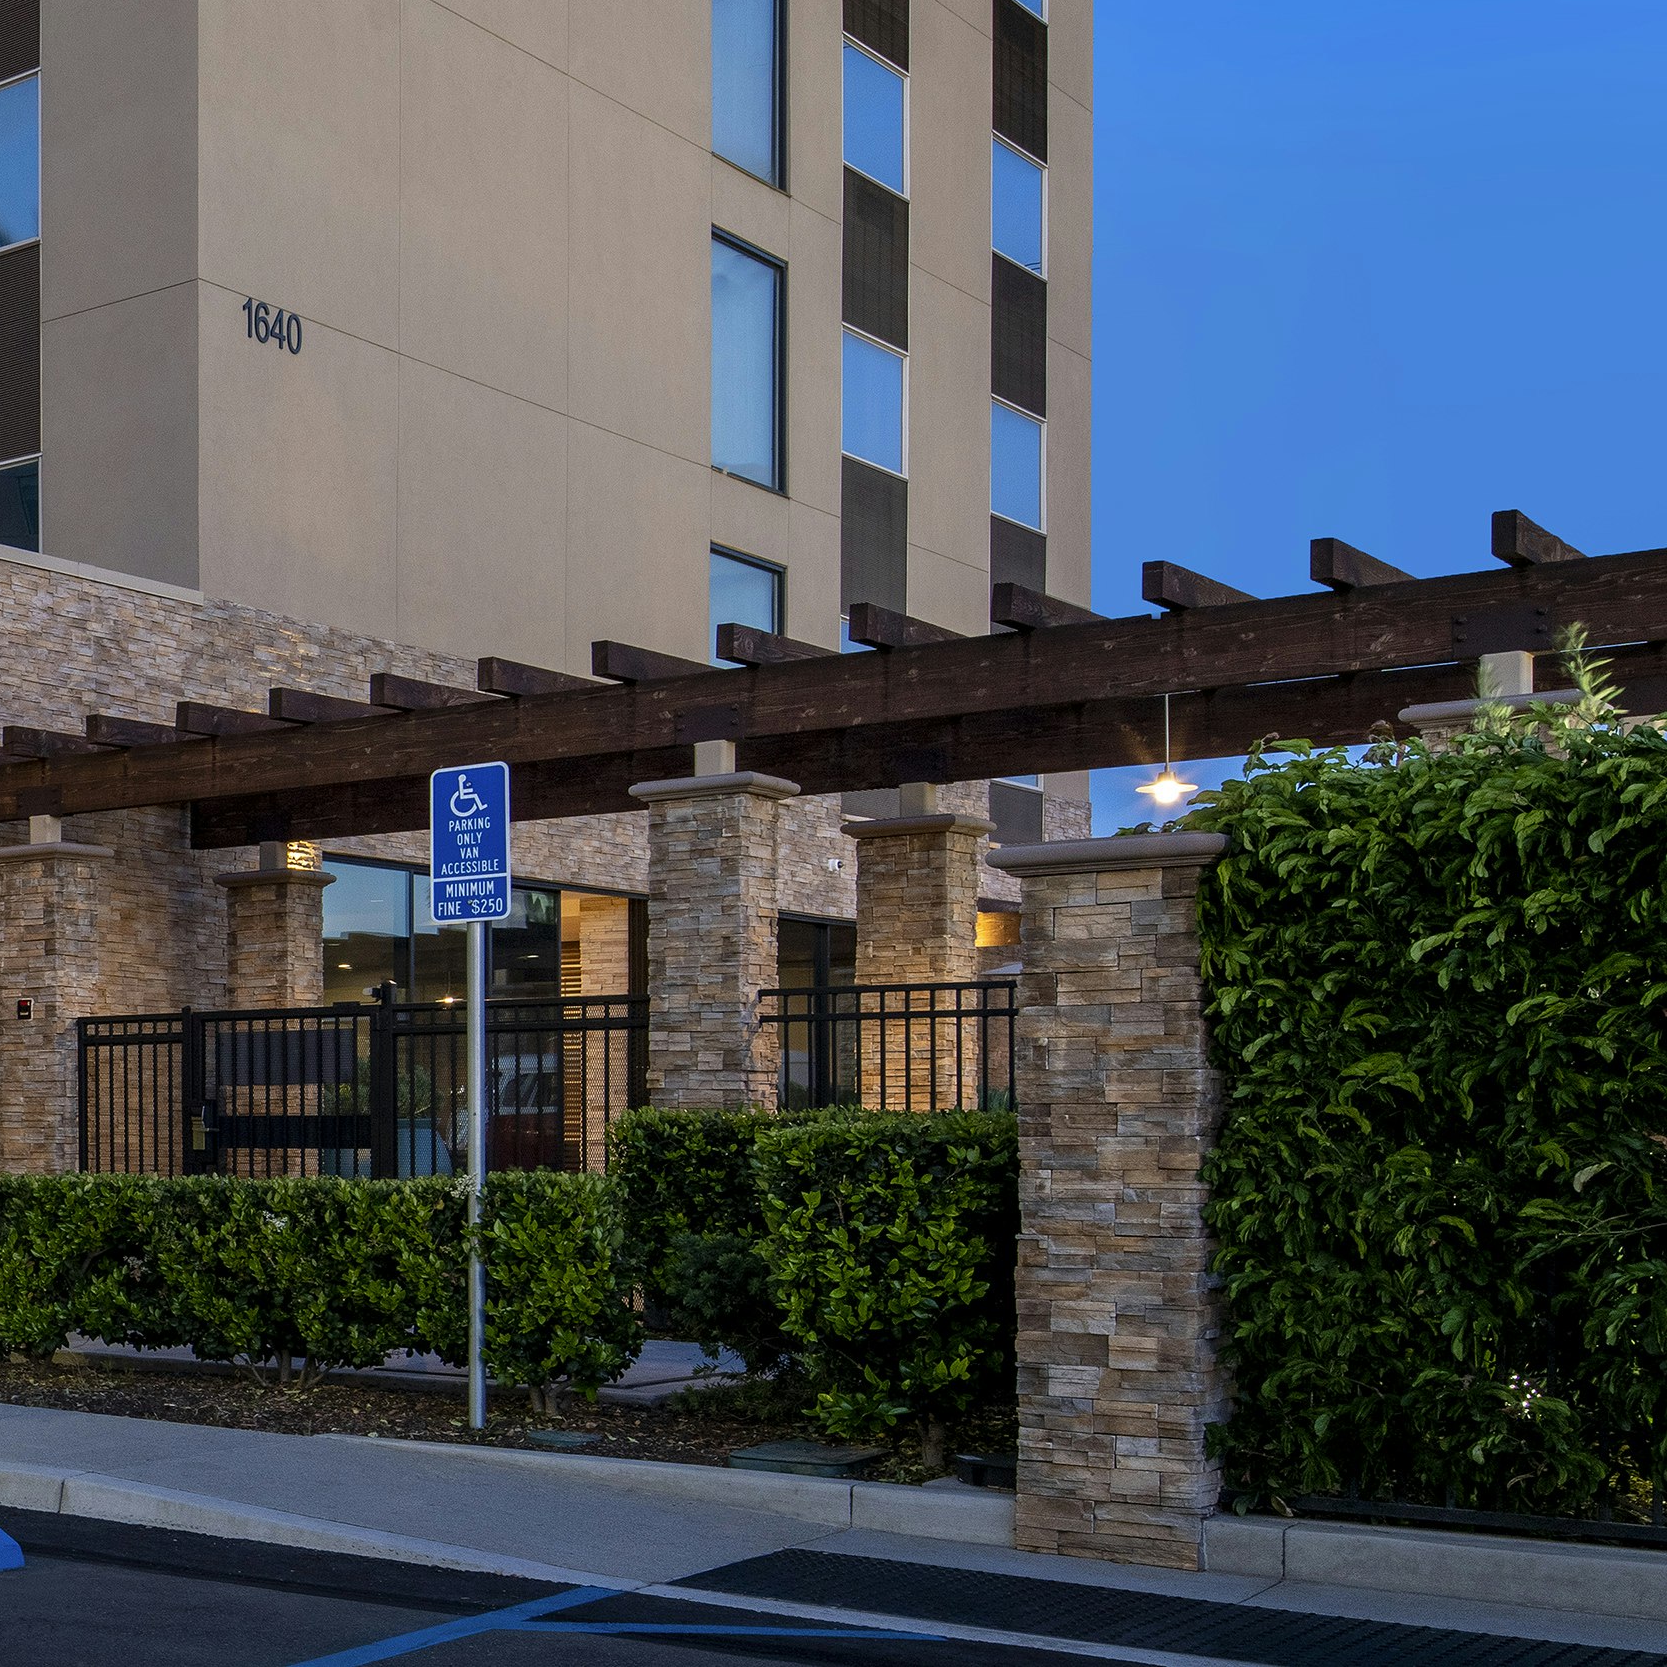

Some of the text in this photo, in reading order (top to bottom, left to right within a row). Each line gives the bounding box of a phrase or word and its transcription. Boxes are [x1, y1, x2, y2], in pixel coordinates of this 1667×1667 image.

[242, 297, 302, 354] 1640
[448, 816, 491, 832] PARKING
[457, 832, 483, 846] ONLY
[460, 847, 479, 860] VAN
[441, 859, 499, 875] ACCESSIBLE
[446, 880, 495, 898] MINIMUM
[438, 898, 503, 916] FINE $250
